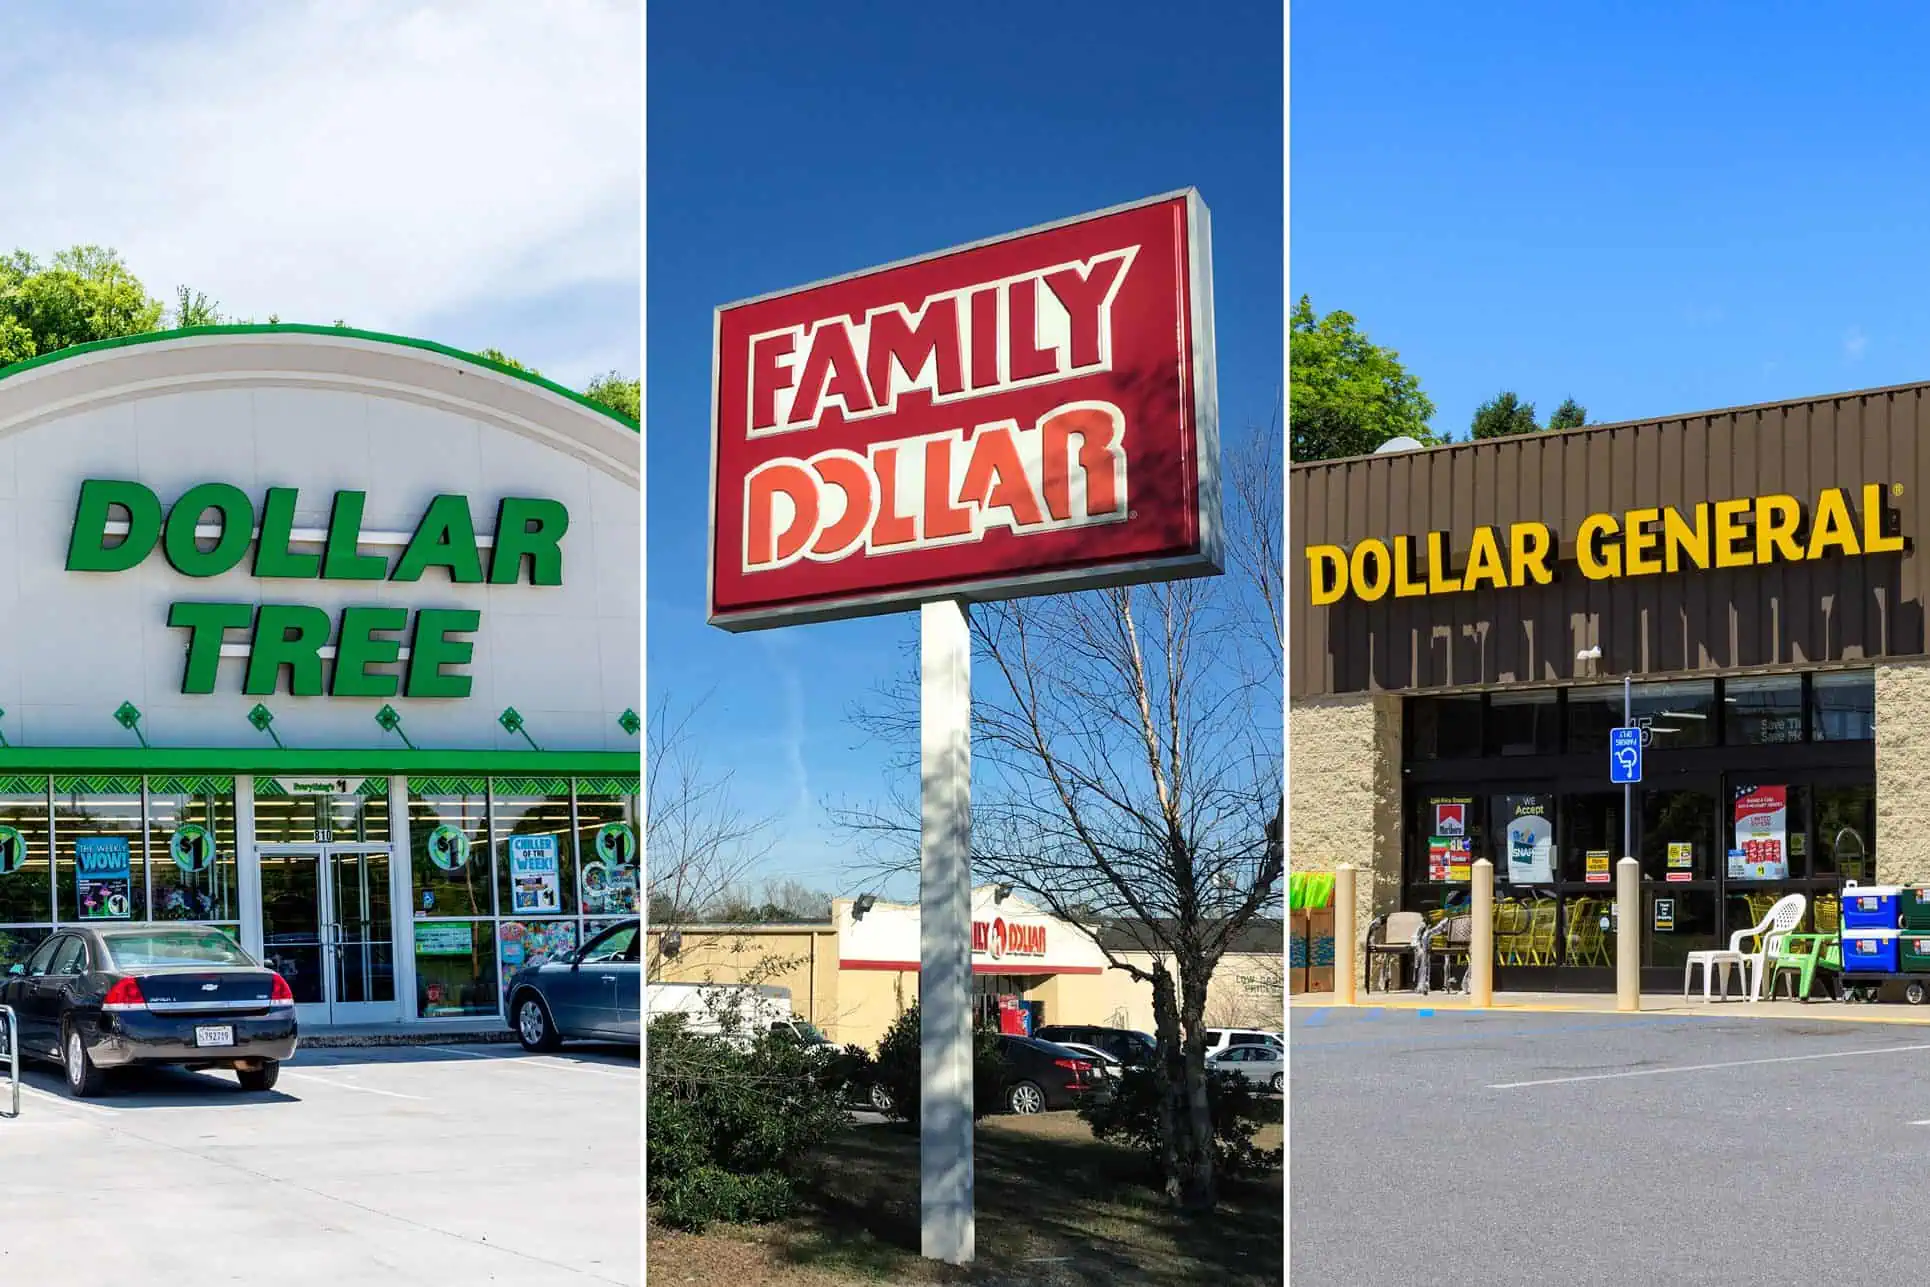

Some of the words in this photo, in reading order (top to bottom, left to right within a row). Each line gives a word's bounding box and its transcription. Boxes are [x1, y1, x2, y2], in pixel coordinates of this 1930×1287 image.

[745, 244, 1141, 440] FAMILY
[742, 401, 1128, 576] DOLLAR
[65, 479, 570, 586] DOLLAR
[1306, 521, 1553, 606] DOLLAR
[1576, 483, 1905, 580] GENERAL
[166, 602, 482, 698] TREE
[1515, 804, 1545, 816] Accept
[1523, 796, 1537, 805] WE
[314, 830, 333, 842] 810
[437, 834, 460, 868] $1
[605, 832, 625, 865] $1
[1511, 847, 1535, 857] SNAP
[81, 852, 127, 870] WOW!
[180, 835, 205, 871] $1
[1008, 923, 1046, 953] DOLLAR
